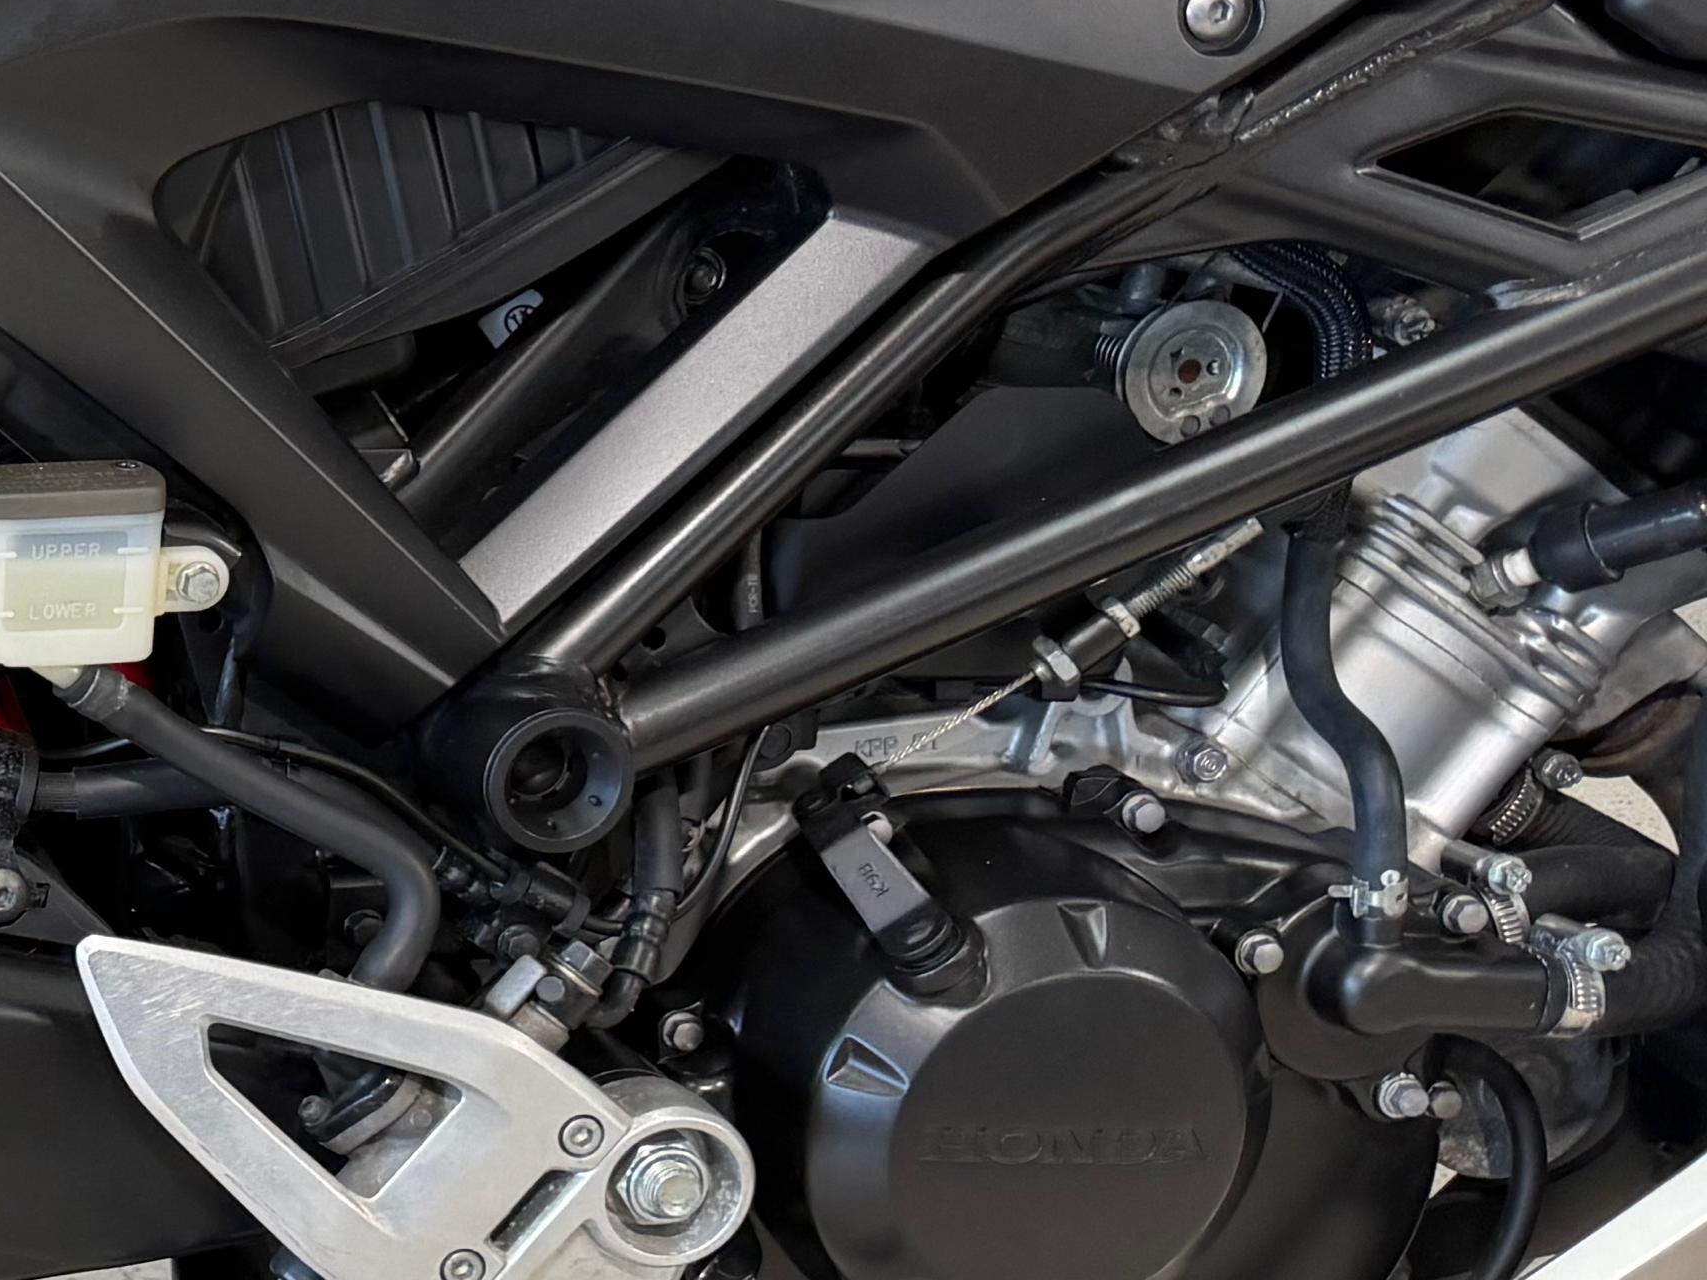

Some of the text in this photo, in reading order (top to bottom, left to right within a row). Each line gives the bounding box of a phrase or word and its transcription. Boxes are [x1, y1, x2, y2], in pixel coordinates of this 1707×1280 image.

[31, 542, 102, 561] UPPER
[28, 601, 98, 620] LOWER
[917, 1126, 1209, 1165] HONDA
